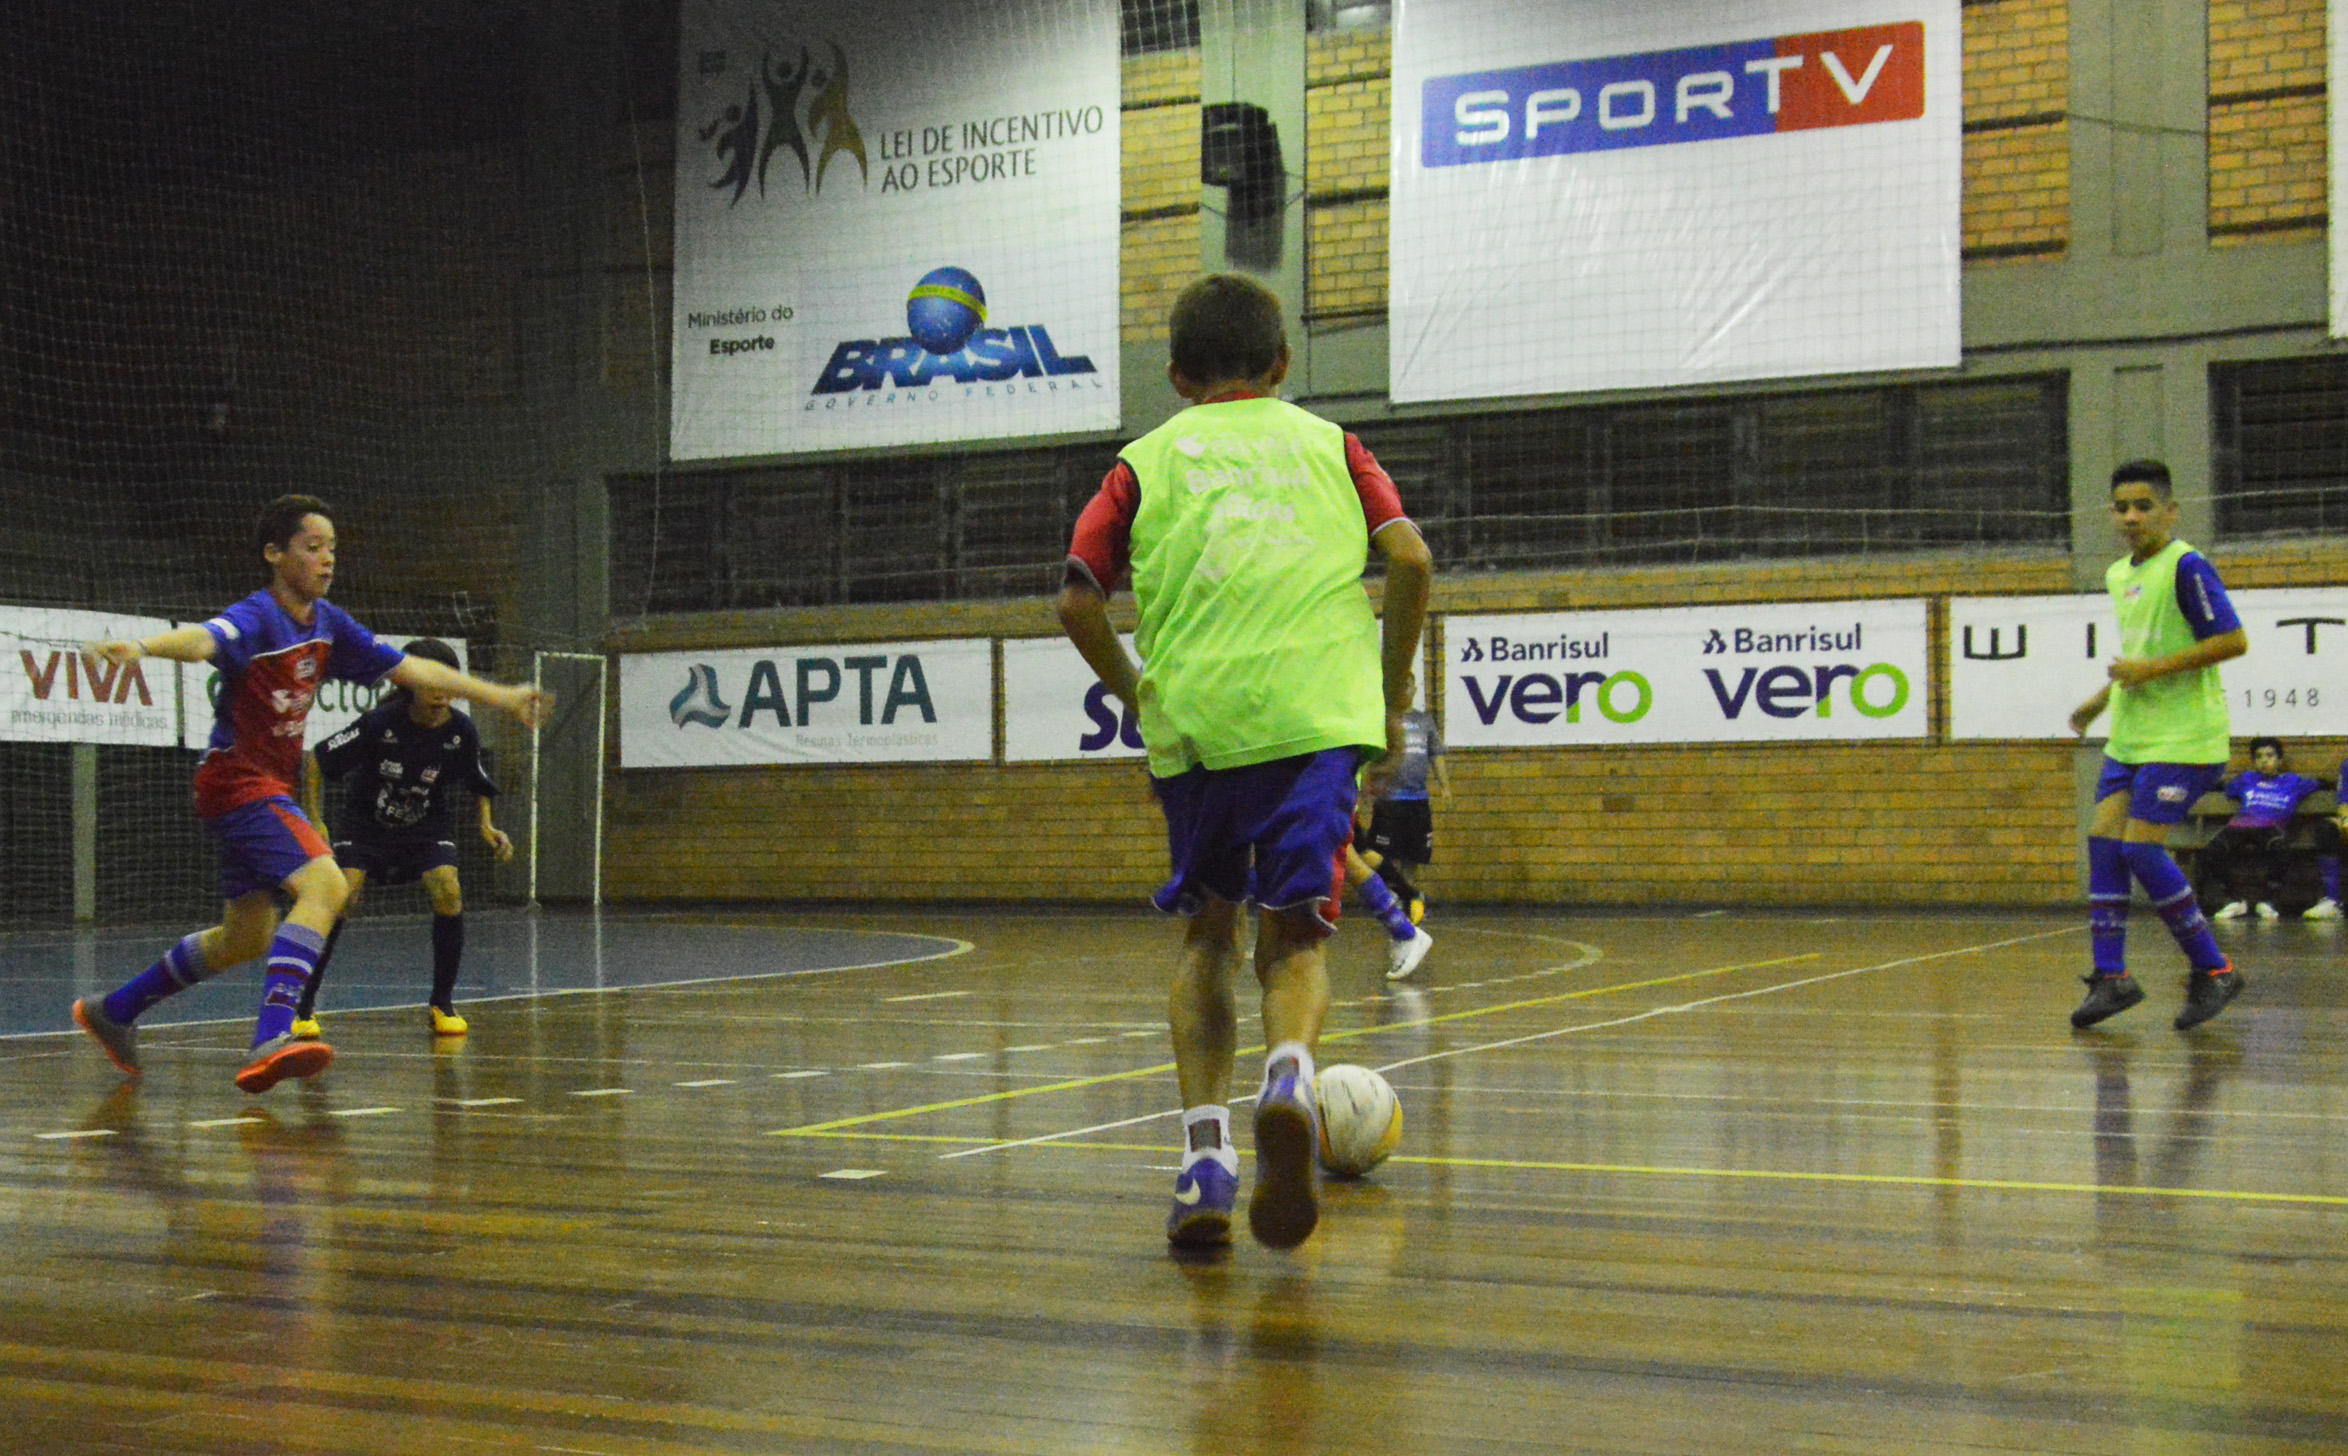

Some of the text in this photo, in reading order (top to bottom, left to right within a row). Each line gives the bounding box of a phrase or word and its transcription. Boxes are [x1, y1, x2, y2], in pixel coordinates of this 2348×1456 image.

[1455, 44, 1894, 146] SPORTV
[881, 105, 1104, 160] LEI DE INCENTIVO
[881, 147, 1037, 193] AO ESPORTE
[688, 304, 794, 329] Ministério do
[710, 334, 775, 356] Esporte
[811, 324, 1098, 395] BRASIL
[805, 377, 1103, 411] GOVERNO FEDERAL
[1491, 631, 1609, 662] Banrisul
[1734, 622, 1861, 654] Banrisul
[19, 649, 154, 706] VIVA
[738, 654, 938, 729] APTA
[1460, 669, 1654, 726] vero
[1702, 662, 1911, 720] vero
[2244, 687, 2320, 709] 1948
